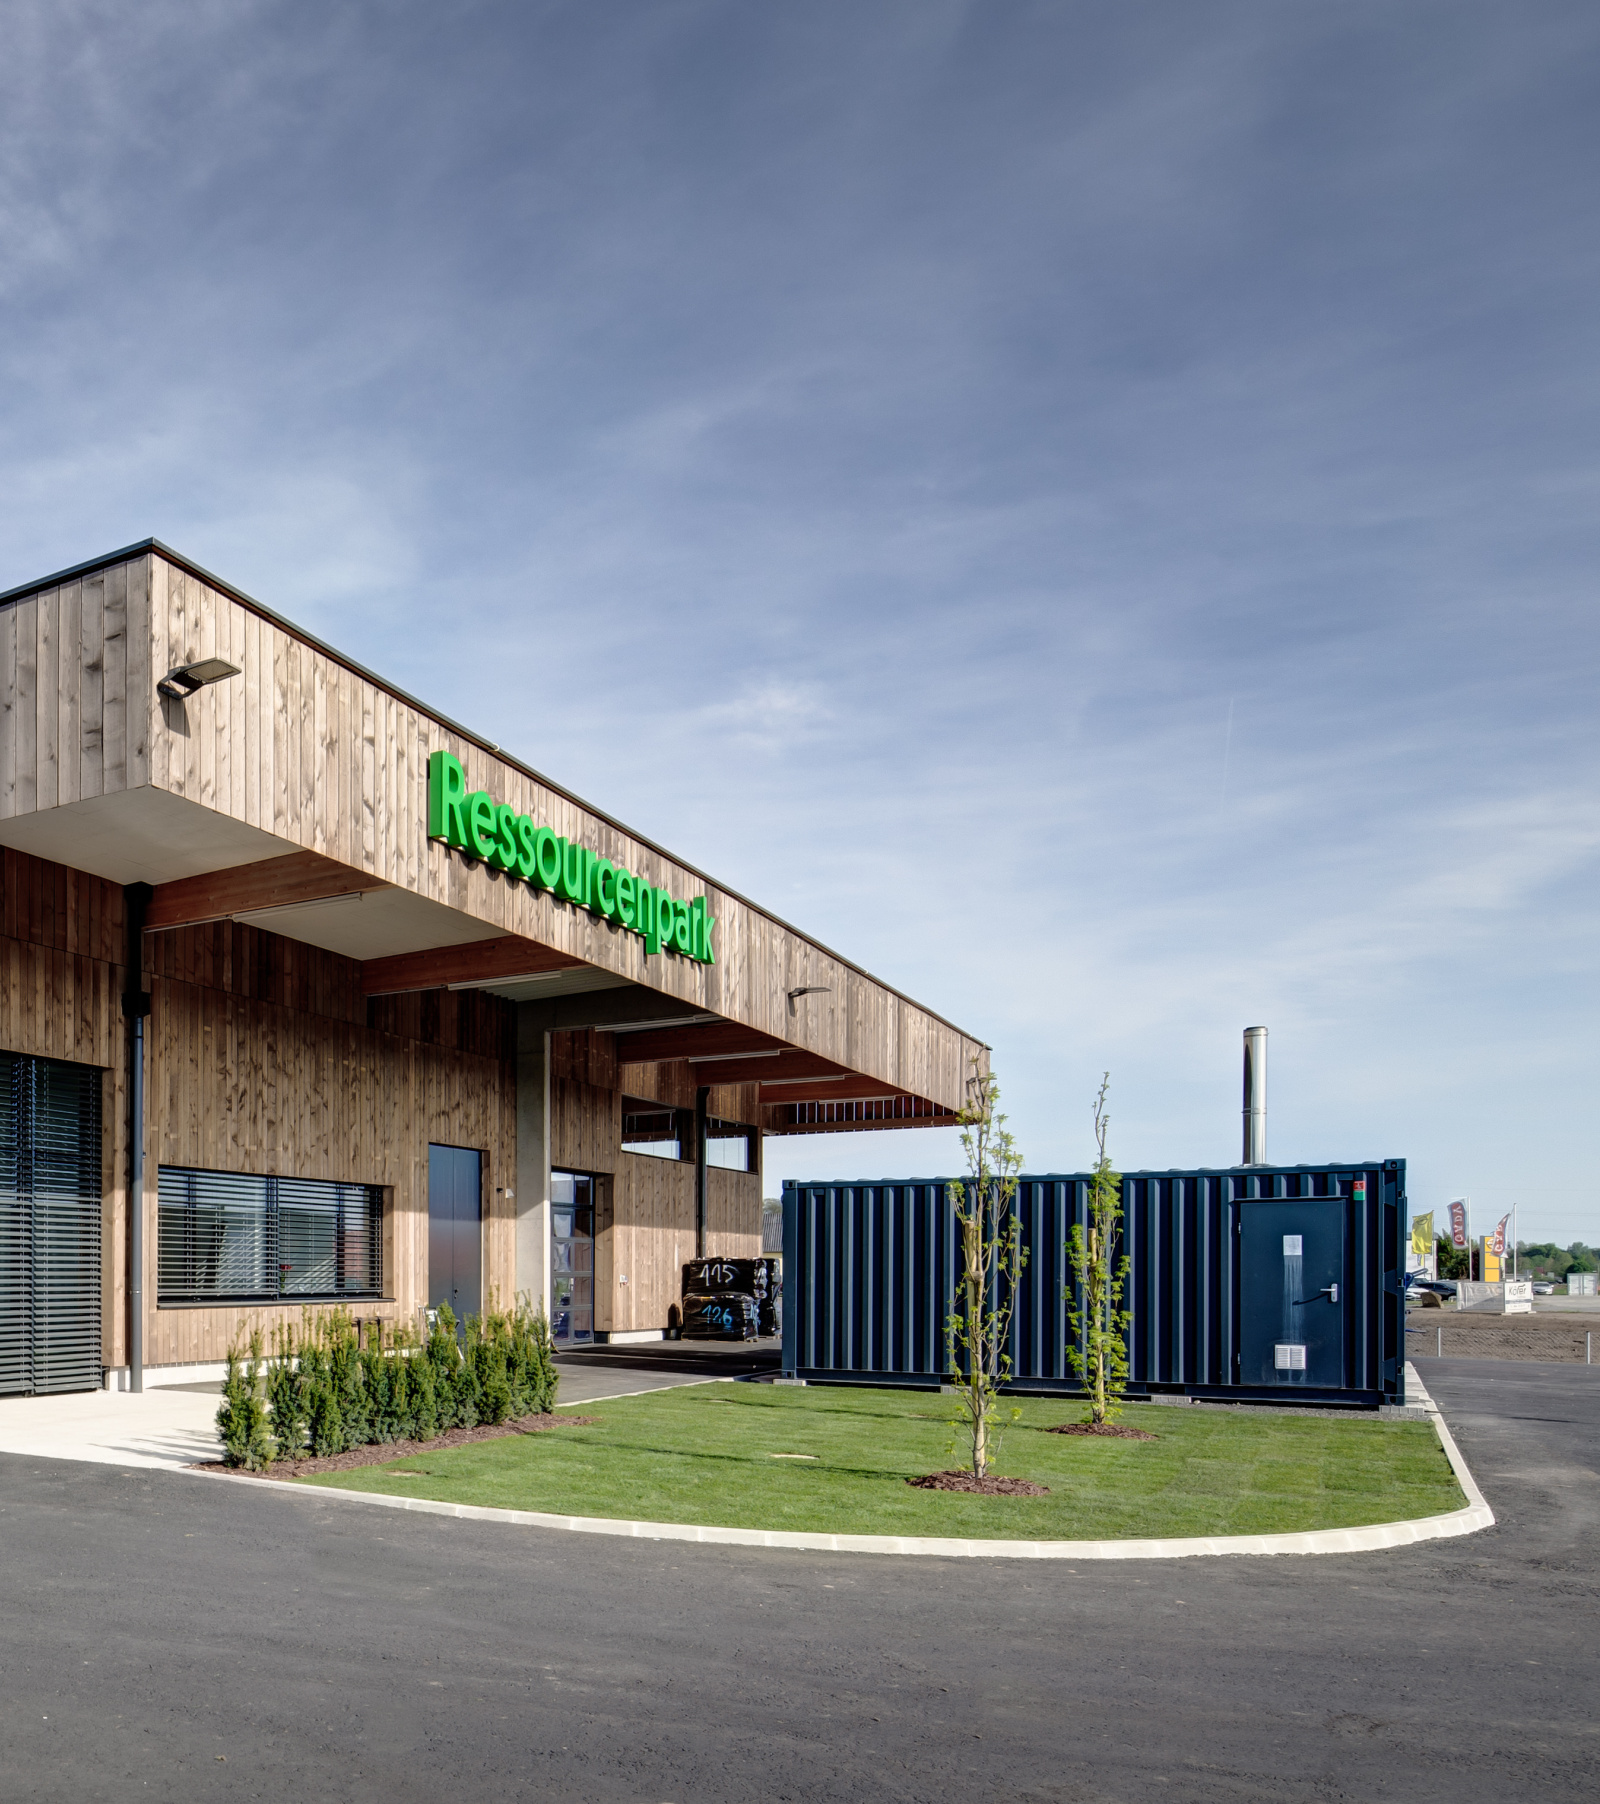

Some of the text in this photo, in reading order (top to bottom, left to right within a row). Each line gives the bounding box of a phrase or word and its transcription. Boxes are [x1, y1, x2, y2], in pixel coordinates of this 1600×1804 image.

[429, 750, 716, 965] Ressourcenpark
[699, 1264, 741, 1287] 115
[701, 1304, 733, 1326] 126
